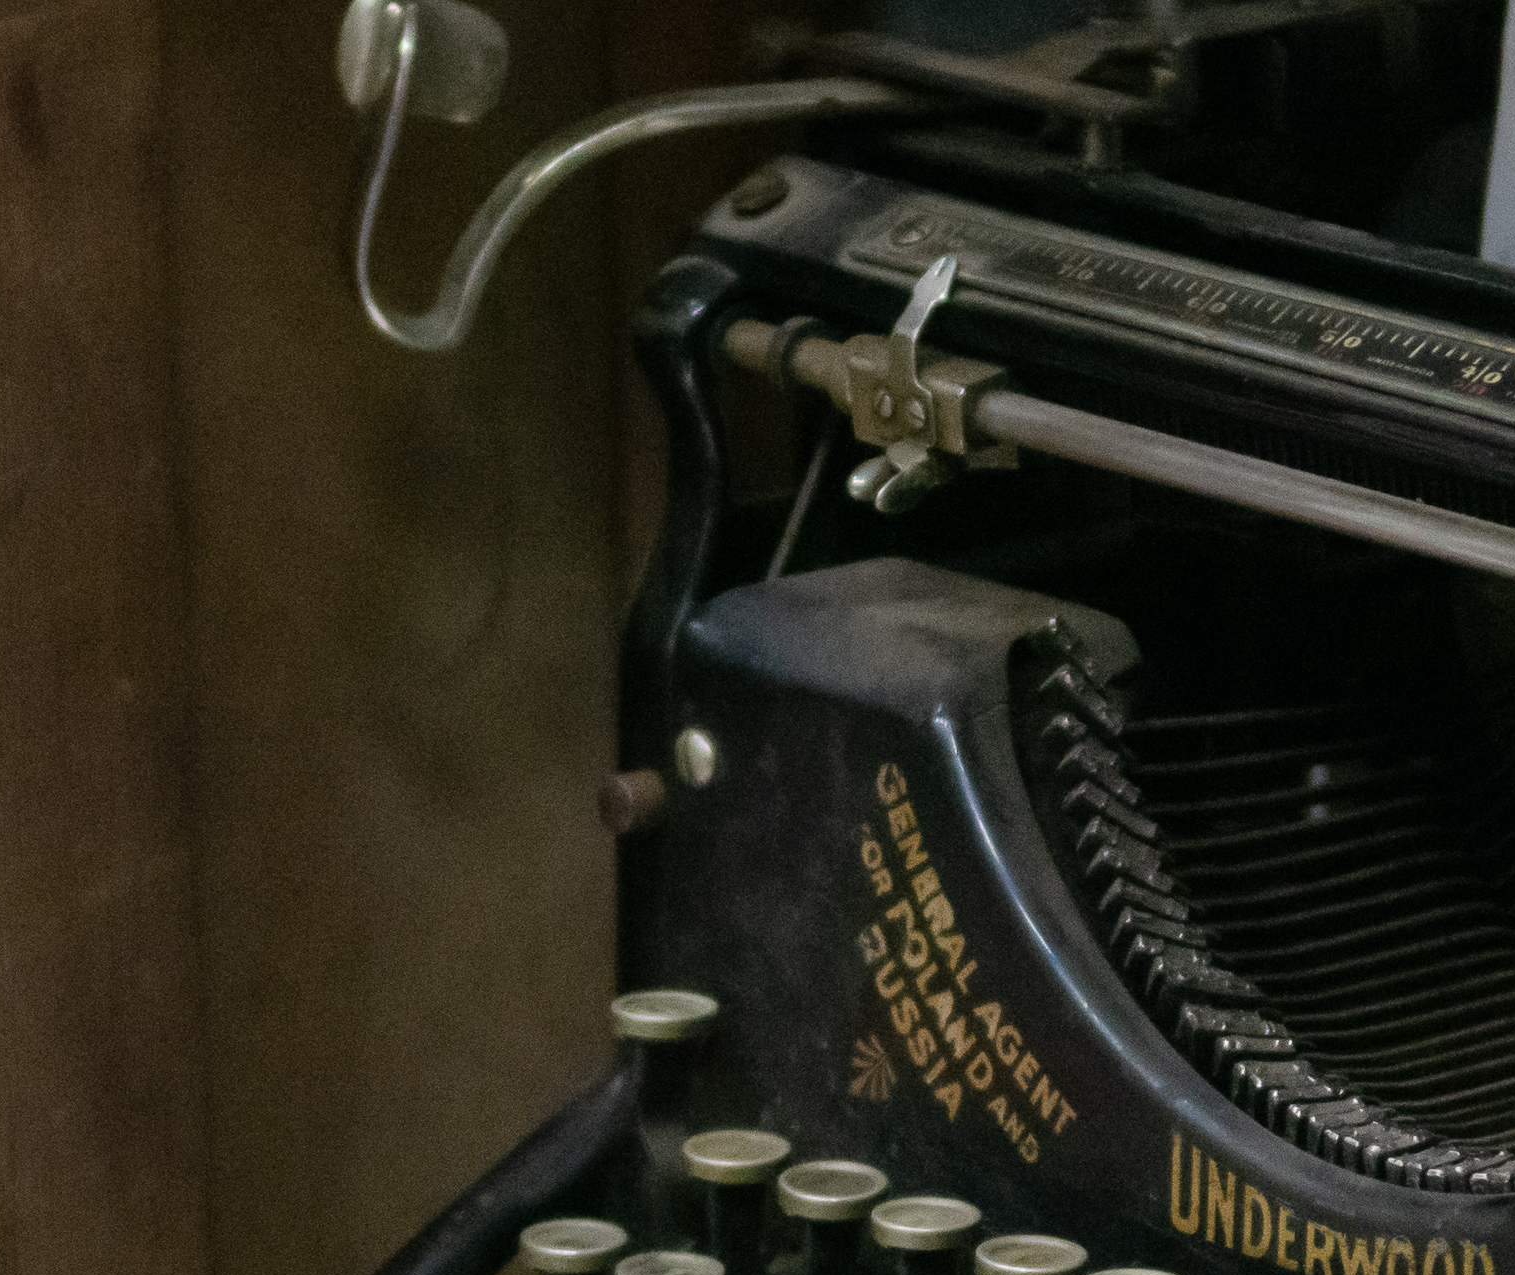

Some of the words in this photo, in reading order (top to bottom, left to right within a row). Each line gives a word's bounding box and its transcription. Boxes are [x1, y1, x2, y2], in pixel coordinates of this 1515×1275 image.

[1460, 364, 1503, 385] 40
[875, 762, 978, 995] GENERAL
[975, 1002, 1078, 1137] AGENT
[885, 899, 994, 1090] POLAND
[986, 1095, 1040, 1165] AND
